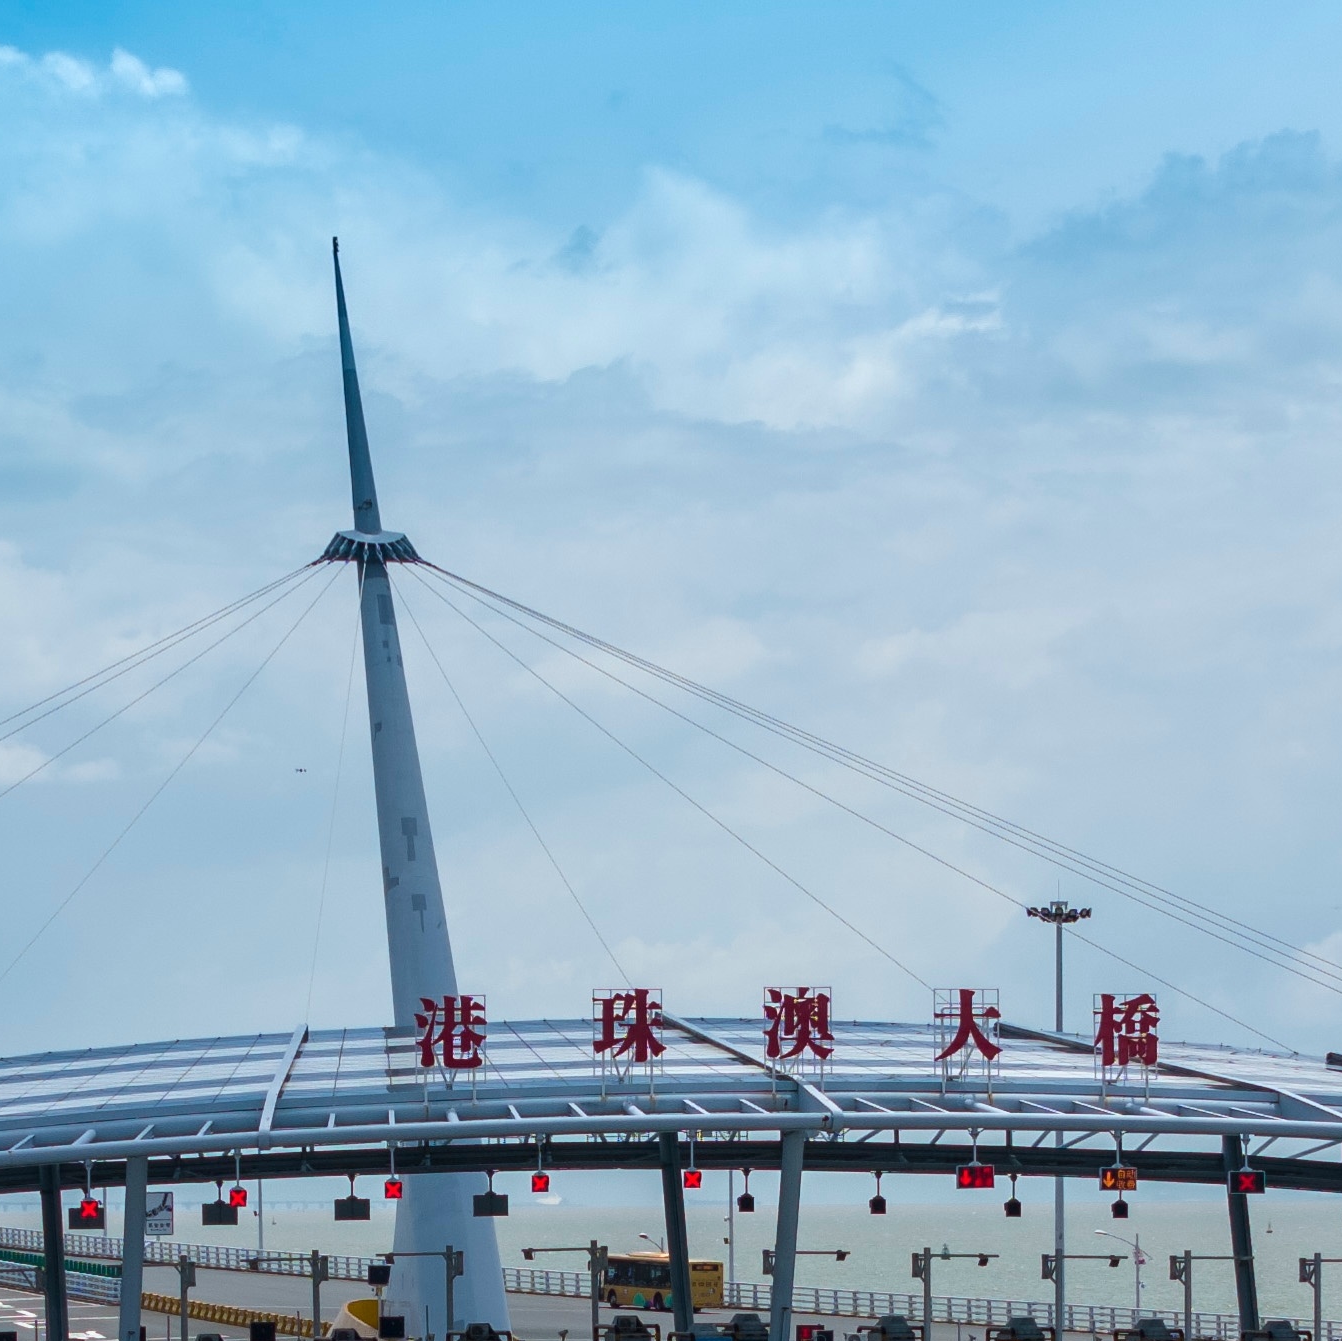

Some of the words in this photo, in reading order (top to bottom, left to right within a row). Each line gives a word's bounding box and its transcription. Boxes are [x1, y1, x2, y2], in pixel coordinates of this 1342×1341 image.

[414, 986, 1161, 1070] 港珠澳大橋
